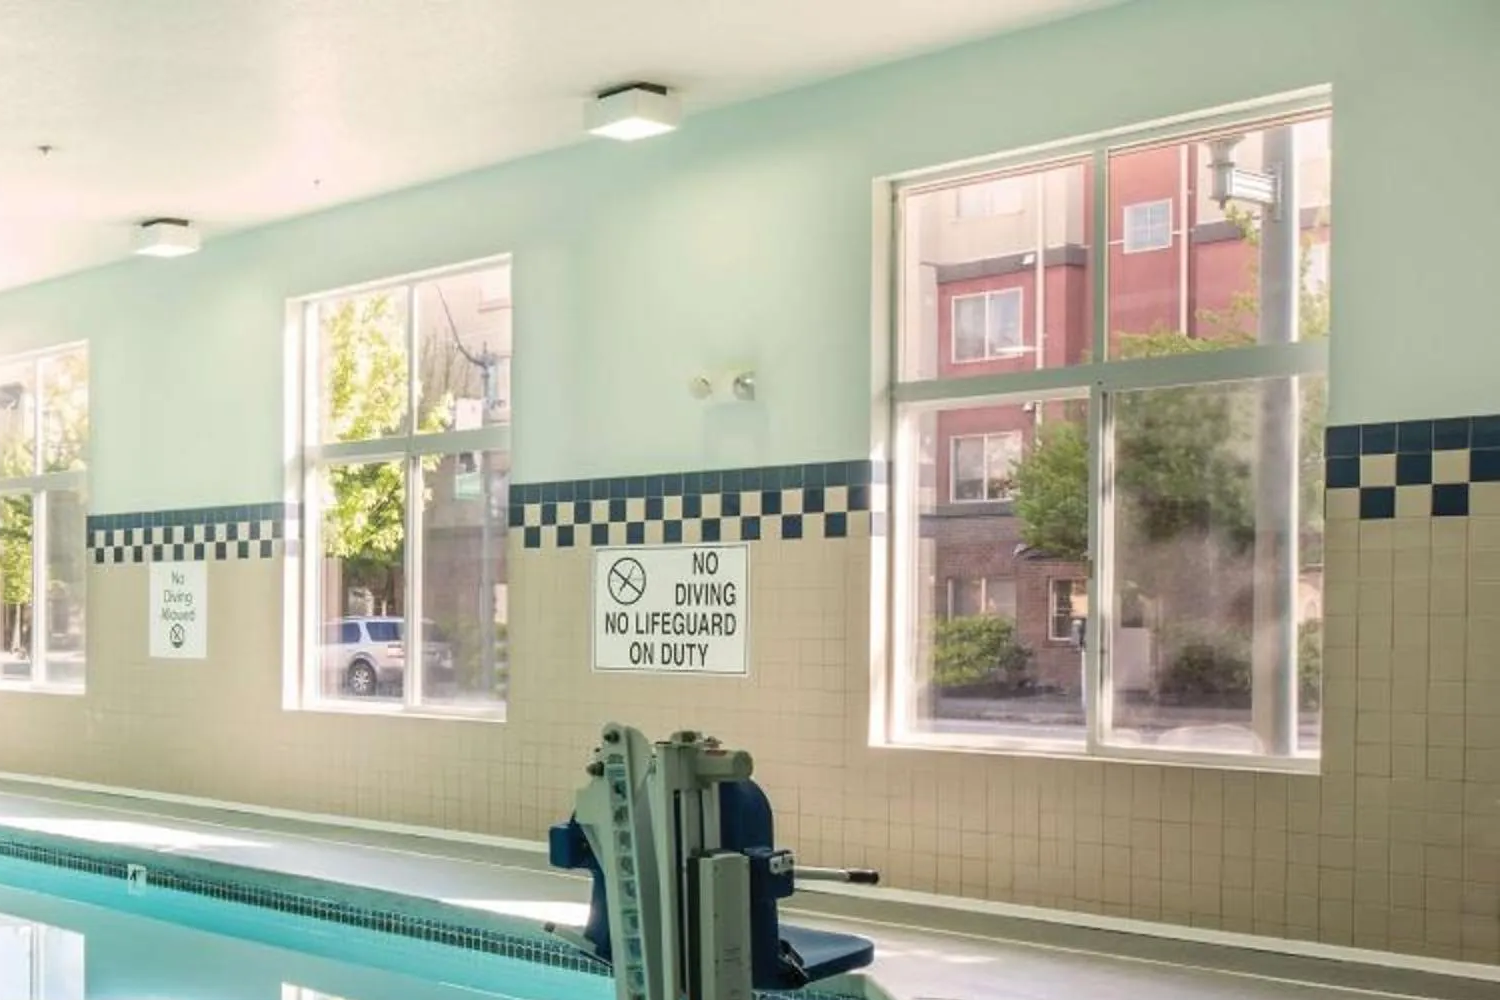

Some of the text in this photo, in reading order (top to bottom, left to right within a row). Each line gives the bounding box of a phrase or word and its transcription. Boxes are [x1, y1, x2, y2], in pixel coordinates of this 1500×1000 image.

[693, 551, 719, 575] NO
[675, 582, 736, 607] DIVING
[605, 612, 737, 636] NO LIFEGUARD
[629, 641, 709, 667] ON DUTY
